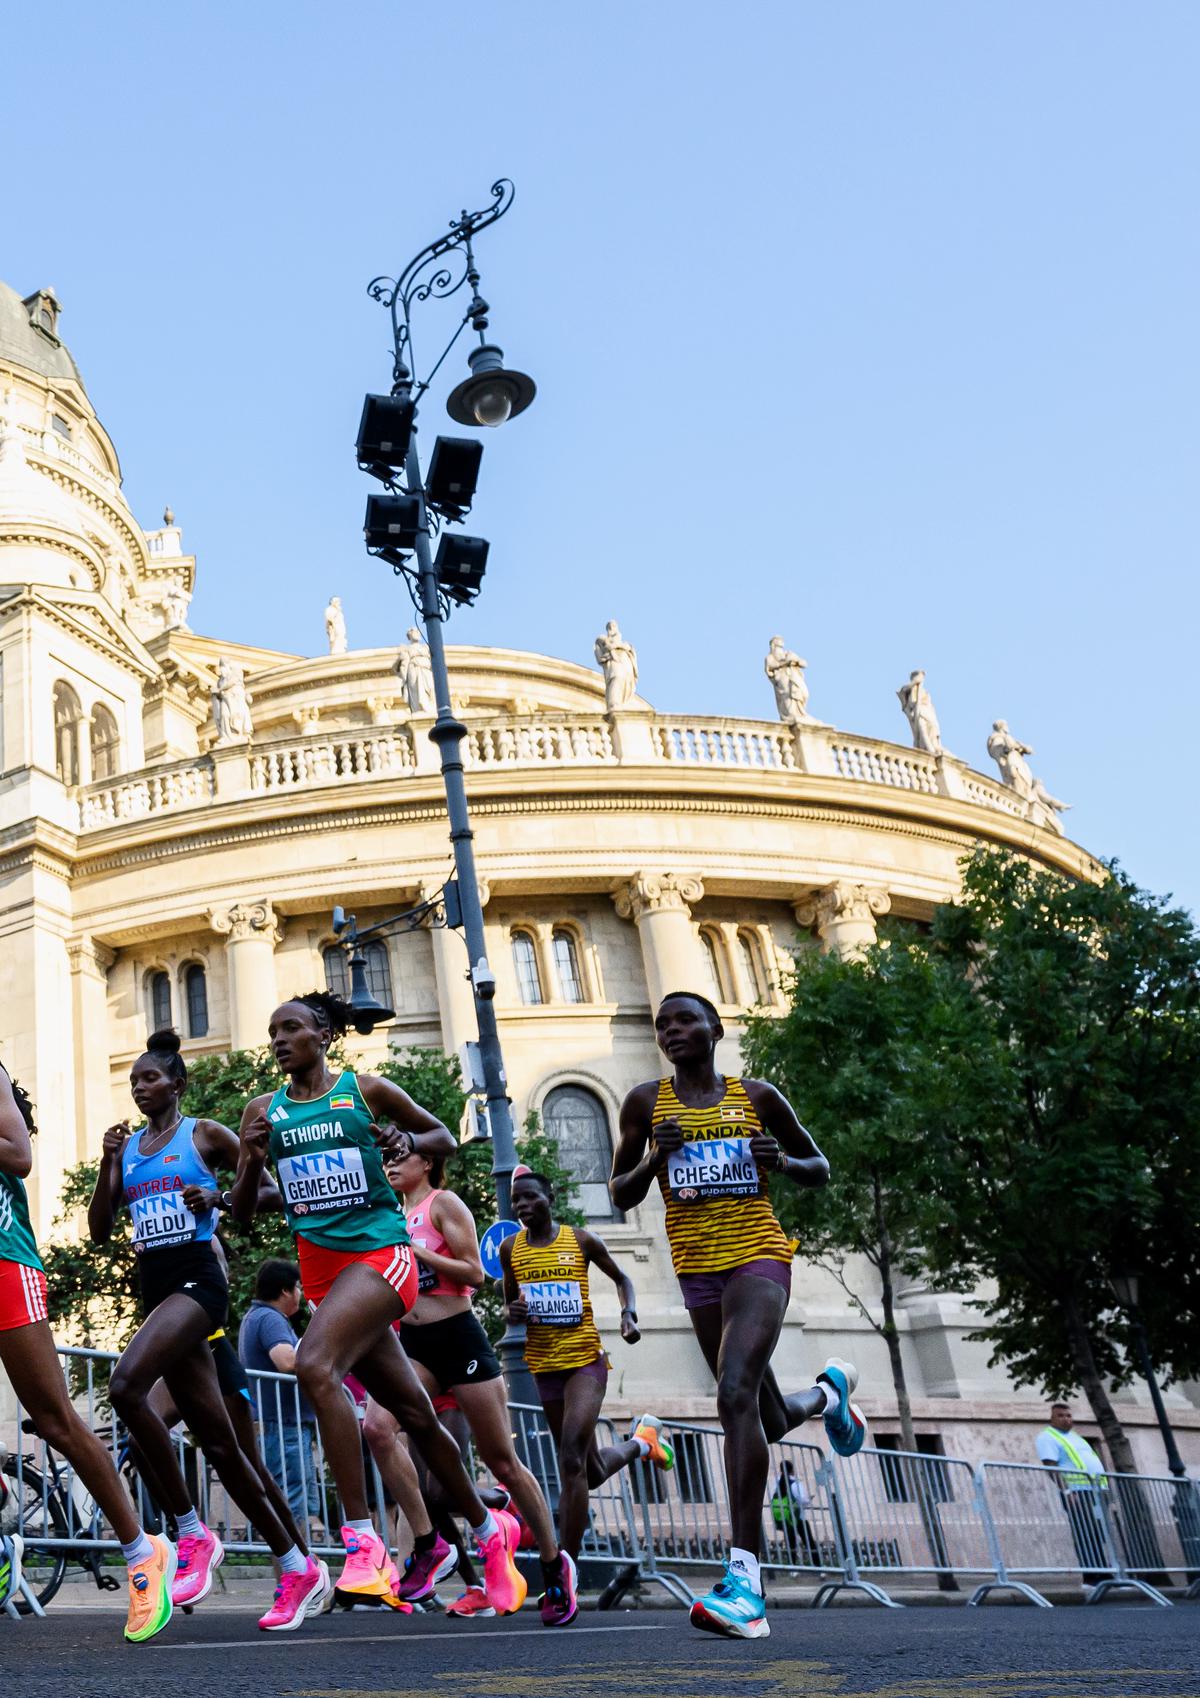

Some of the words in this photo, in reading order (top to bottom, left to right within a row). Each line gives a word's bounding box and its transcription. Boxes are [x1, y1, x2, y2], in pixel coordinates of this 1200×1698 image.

[281, 1121, 344, 1147] ETHIOPIA
[682, 1125, 744, 1141] GANDA
[683, 1139, 743, 1163] NTN
[290, 1151, 345, 1177] NTN
[673, 1162, 754, 1185] CHESANG
[288, 1171, 361, 1200] GEMECHU
[700, 1187, 748, 1196] BUDAPEST
[136, 1193, 177, 1216] NTN
[310, 1198, 352, 1211] BUDAPEST
[353, 1197, 364, 1205] 23
[146, 1235, 183, 1248] BUDAPEST
[522, 1268, 574, 1280] UGANDA
[530, 1283, 571, 1297] NTN
[528, 1300, 579, 1313] HELANGAT
